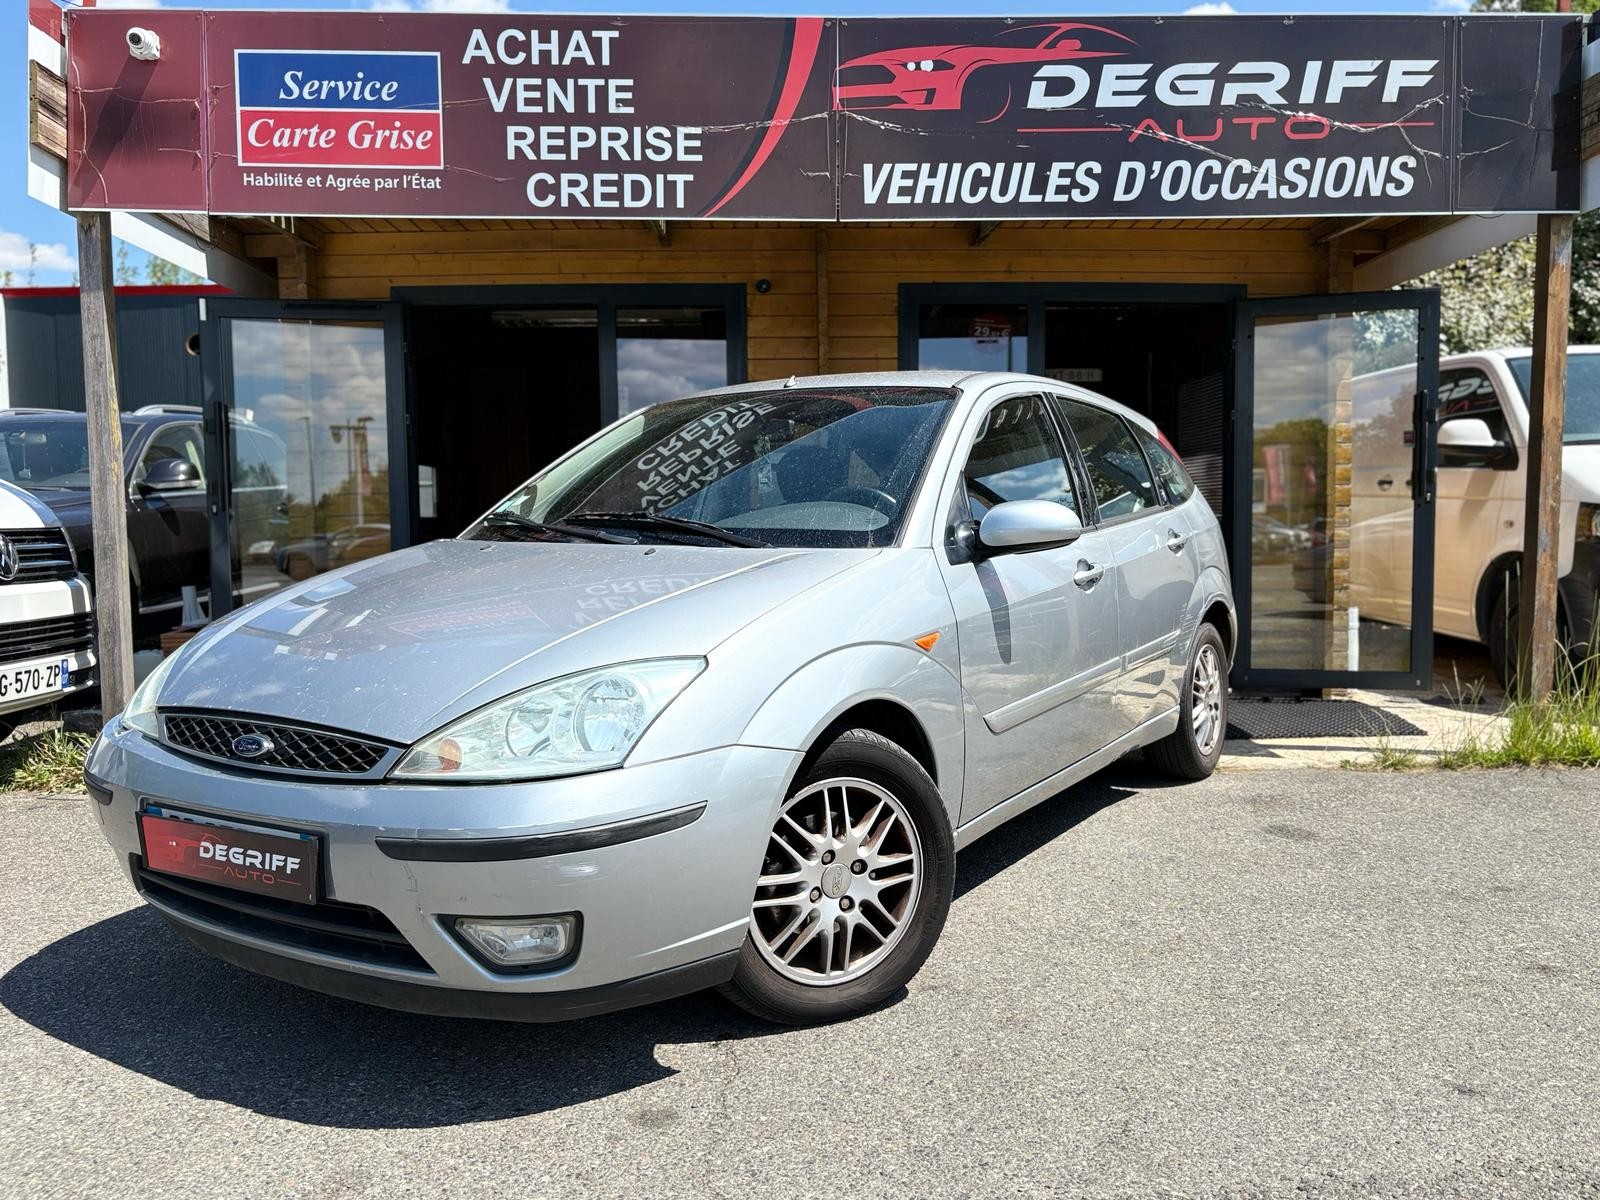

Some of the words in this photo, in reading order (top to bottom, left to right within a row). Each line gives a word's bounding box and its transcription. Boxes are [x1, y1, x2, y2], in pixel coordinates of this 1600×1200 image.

[462, 29, 620, 66] ACHAT
[279, 70, 399, 101] Service
[482, 77, 635, 114] VENTE
[1027, 59, 1440, 109] DEGRIFF
[247, 118, 337, 149] Carte
[347, 120, 433, 150] Grise
[506, 125, 703, 162] REPRISE
[1128, 116, 1331, 143] AUTO
[243, 172, 303, 188] Habilité
[306, 174, 322, 188] et
[325, 174, 371, 192] Agrée
[374, 177, 400, 192] par
[526, 172, 694, 209] CREDIT
[863, 160, 1102, 205] VEHICULES
[1113, 155, 1417, 202] D'OCCASIONS
[199, 841, 301, 875] DEGRIFF
[223, 866, 275, 885] AUTO
